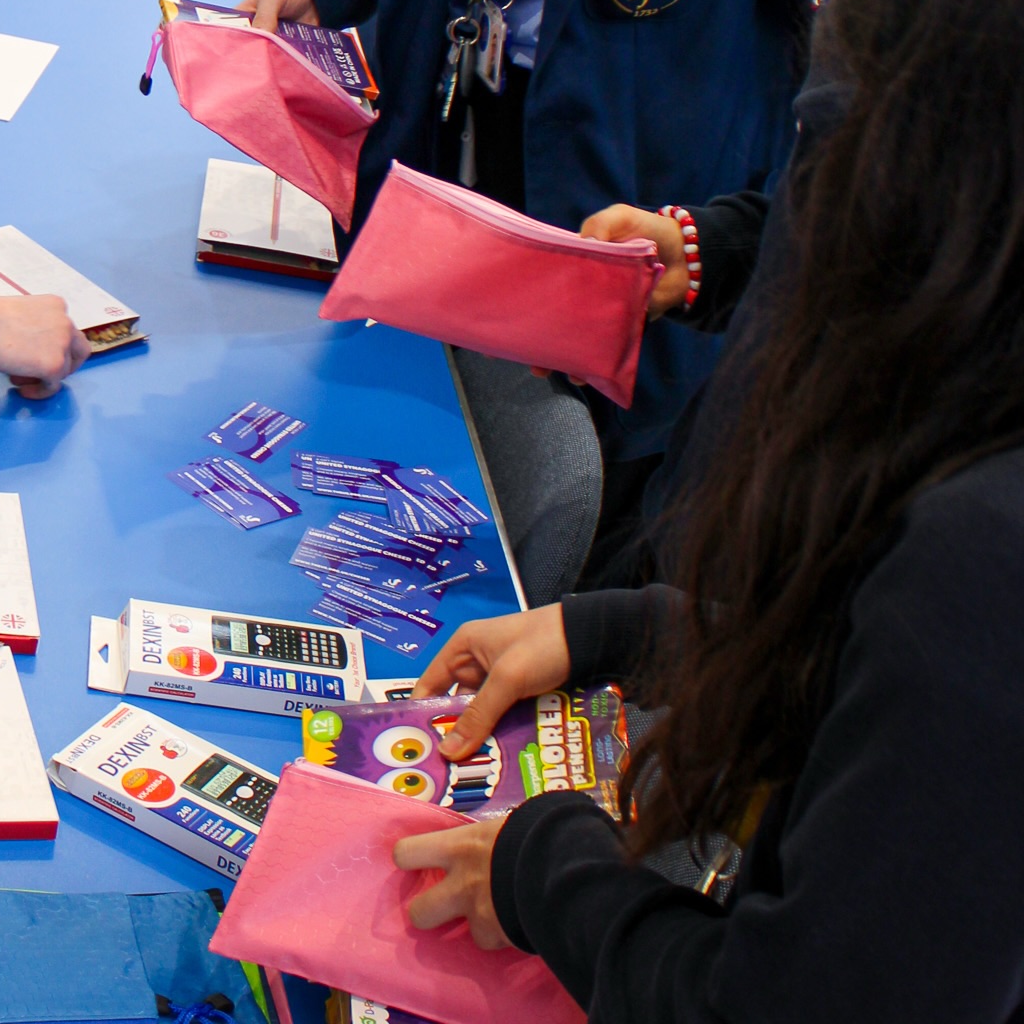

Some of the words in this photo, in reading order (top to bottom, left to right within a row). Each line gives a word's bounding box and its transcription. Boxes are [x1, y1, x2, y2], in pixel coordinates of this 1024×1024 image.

[308, 530, 337, 541] UNITED
[336, 538, 383, 555] SYNAGOGUE
[382, 550, 413, 562] CHESED
[407, 539, 437, 553] CHESED
[336, 583, 364, 598] UNITED
[363, 594, 409, 616] SYNAGOGUE
[407, 613, 437, 629] CHESED
[232, 667, 242, 680] 240
[314, 719, 328, 735] 12
[537, 695, 570, 792] OLORED
[567, 721, 587, 785] PENCILS
[137, 775, 168, 800] KK-82MS-B
[176, 805, 192, 818] 240
